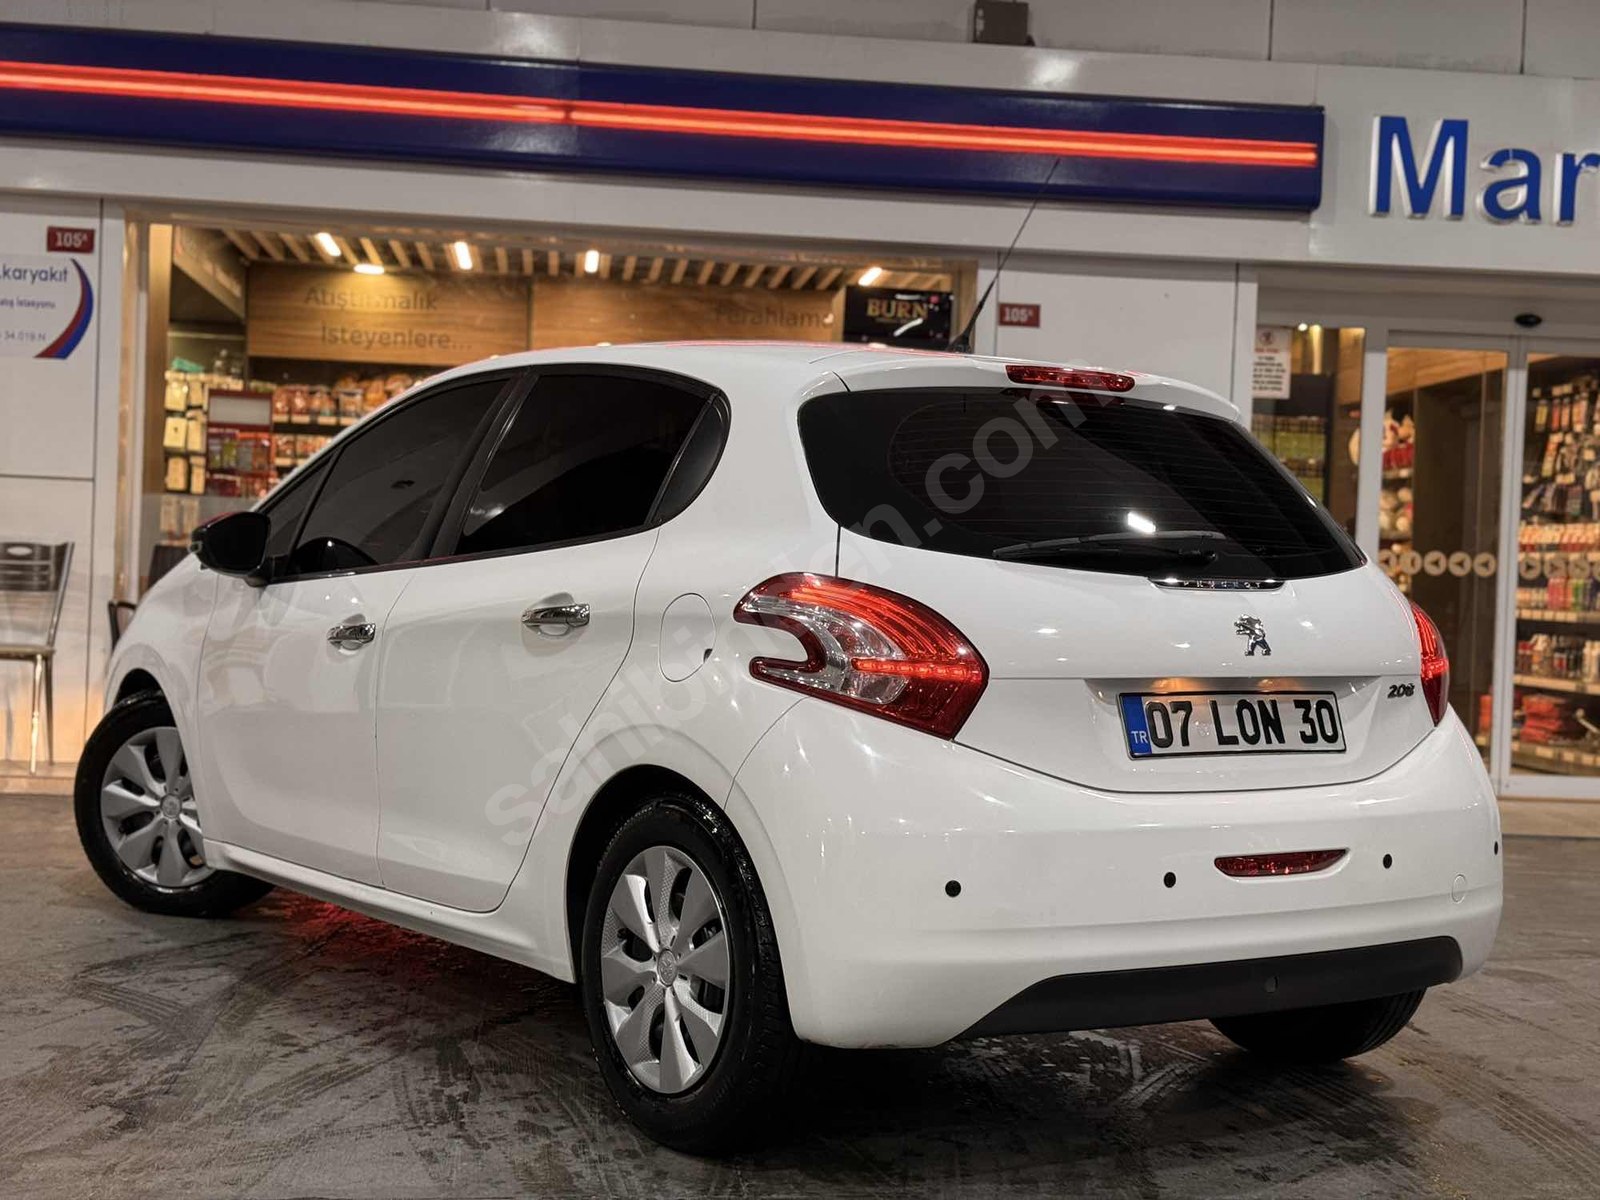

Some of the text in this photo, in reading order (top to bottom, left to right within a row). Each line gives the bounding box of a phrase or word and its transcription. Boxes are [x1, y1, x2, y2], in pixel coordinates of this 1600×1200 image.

[1369, 115, 1600, 226] Mar
[0, 263, 68, 285] karyakıt
[1387, 682, 1415, 699] 208
[1145, 699, 1340, 748] 07 LON 30
[1131, 730, 1149, 745] TR
